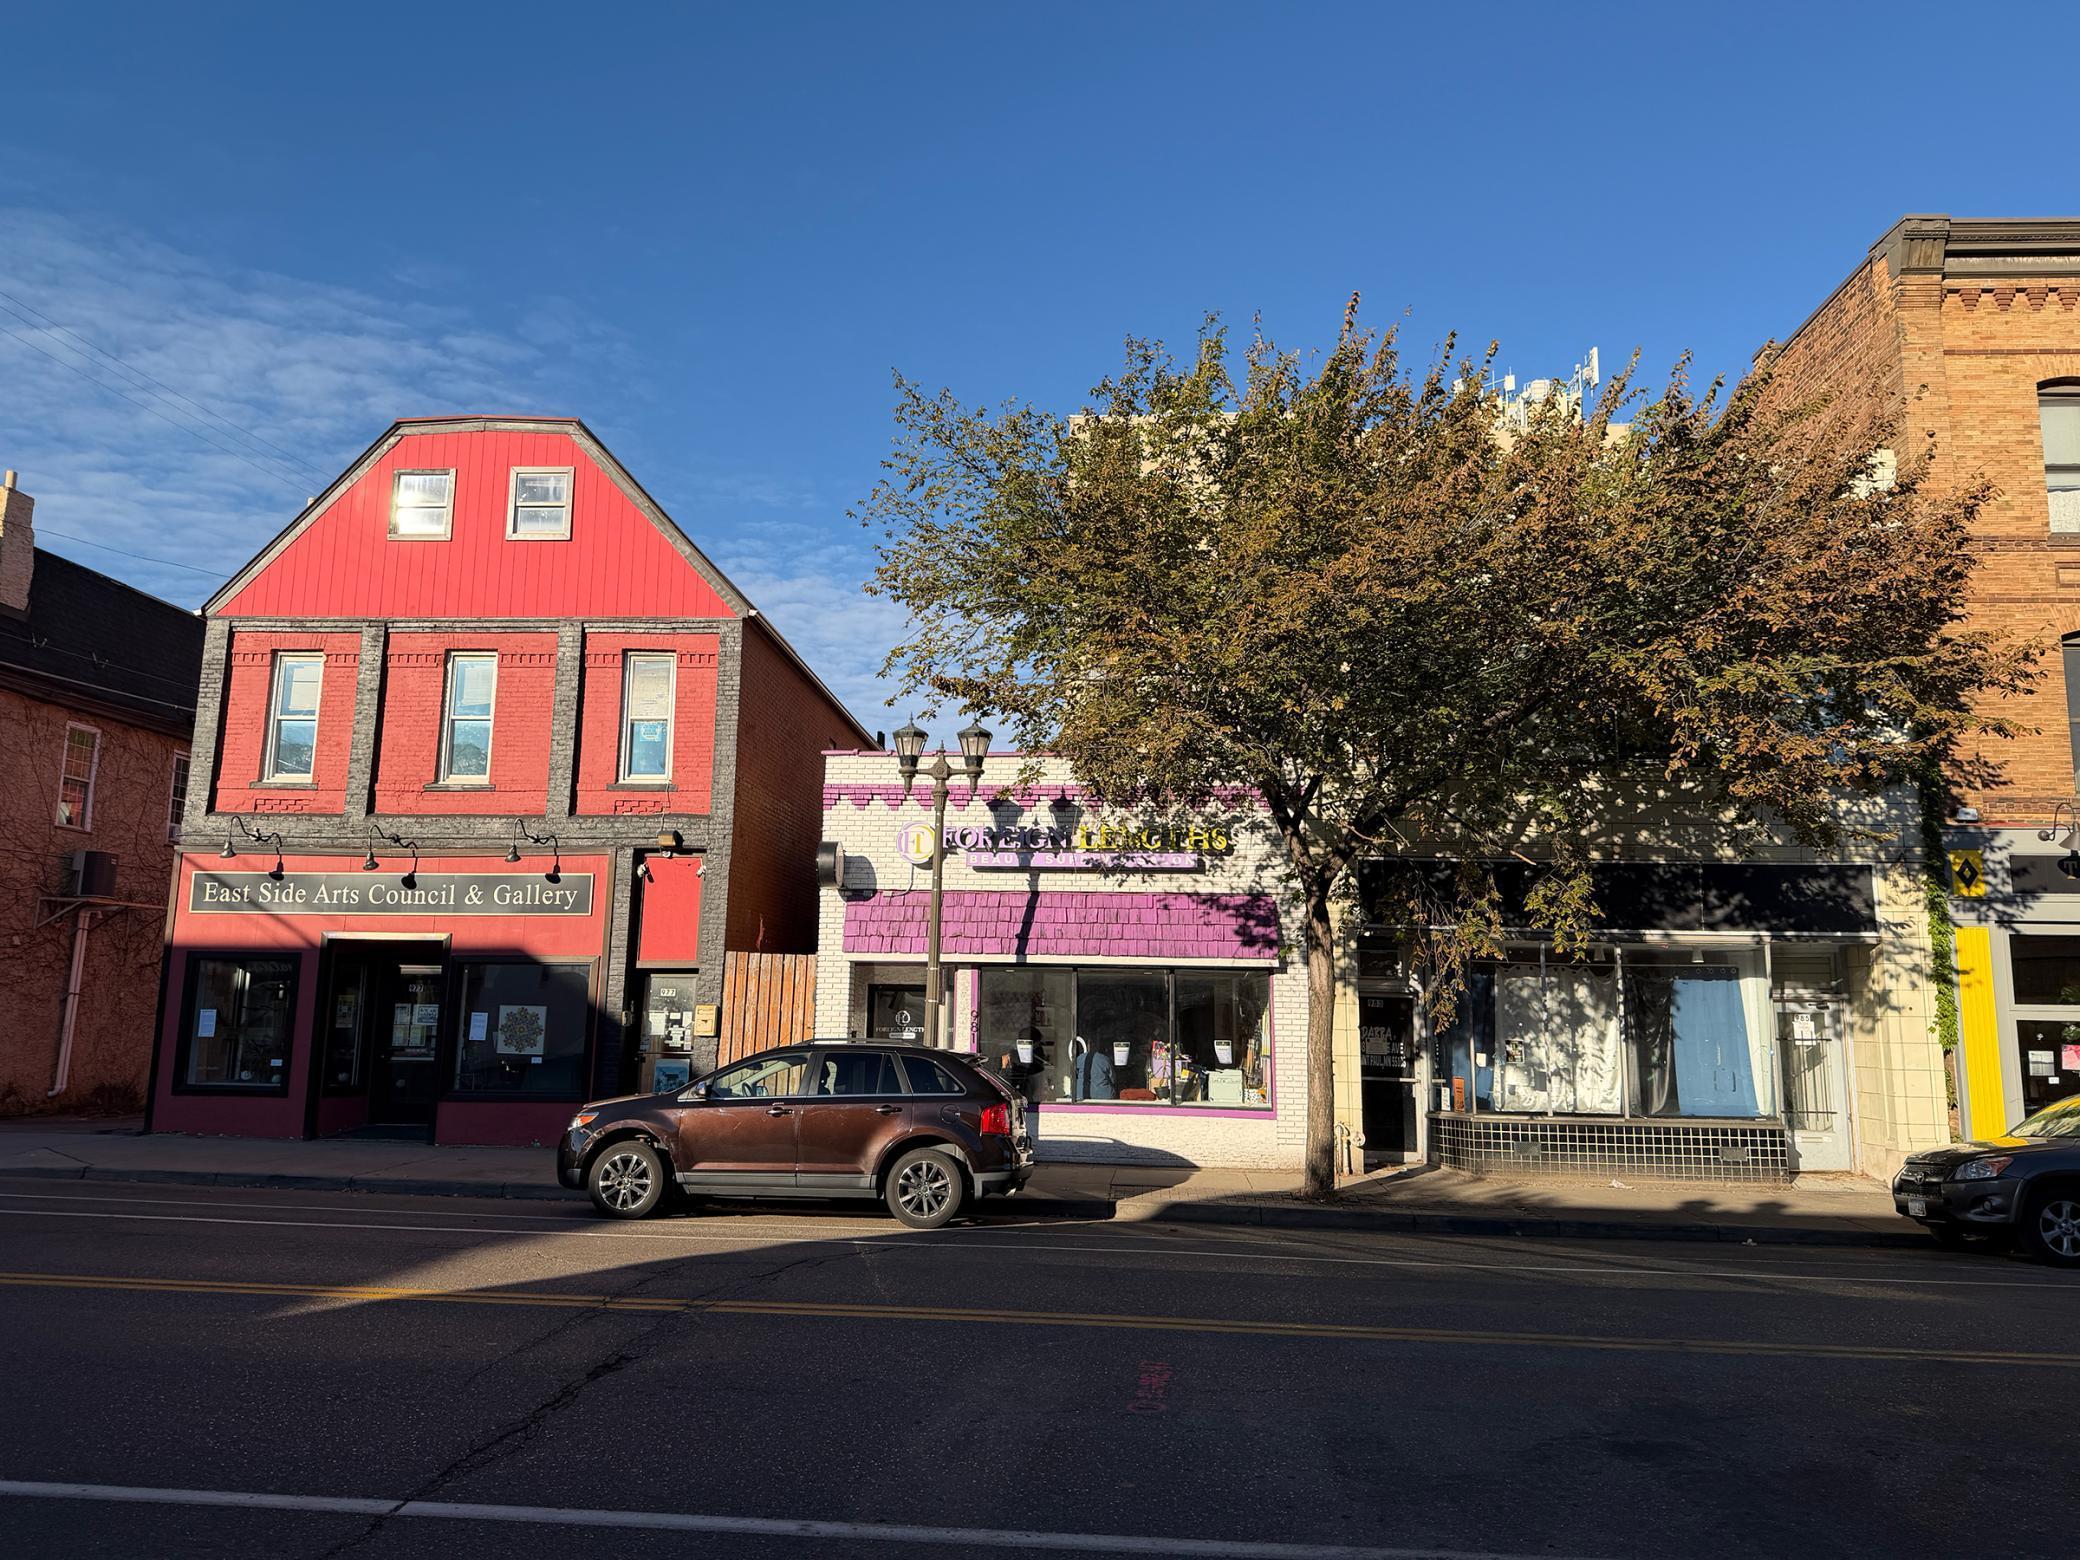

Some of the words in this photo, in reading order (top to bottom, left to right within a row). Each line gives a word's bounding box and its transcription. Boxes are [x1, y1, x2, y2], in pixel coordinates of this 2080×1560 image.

[943, 825, 1071, 848] FOREIGN
[203, 882, 250, 902] East
[258, 882, 306, 903] Side
[312, 883, 360, 904] Arts
[368, 884, 456, 905] Council
[464, 884, 484, 904] &
[493, 884, 578, 910] Gallery
[661, 988, 675, 996] 977
[970, 1010, 979, 1043] 981
